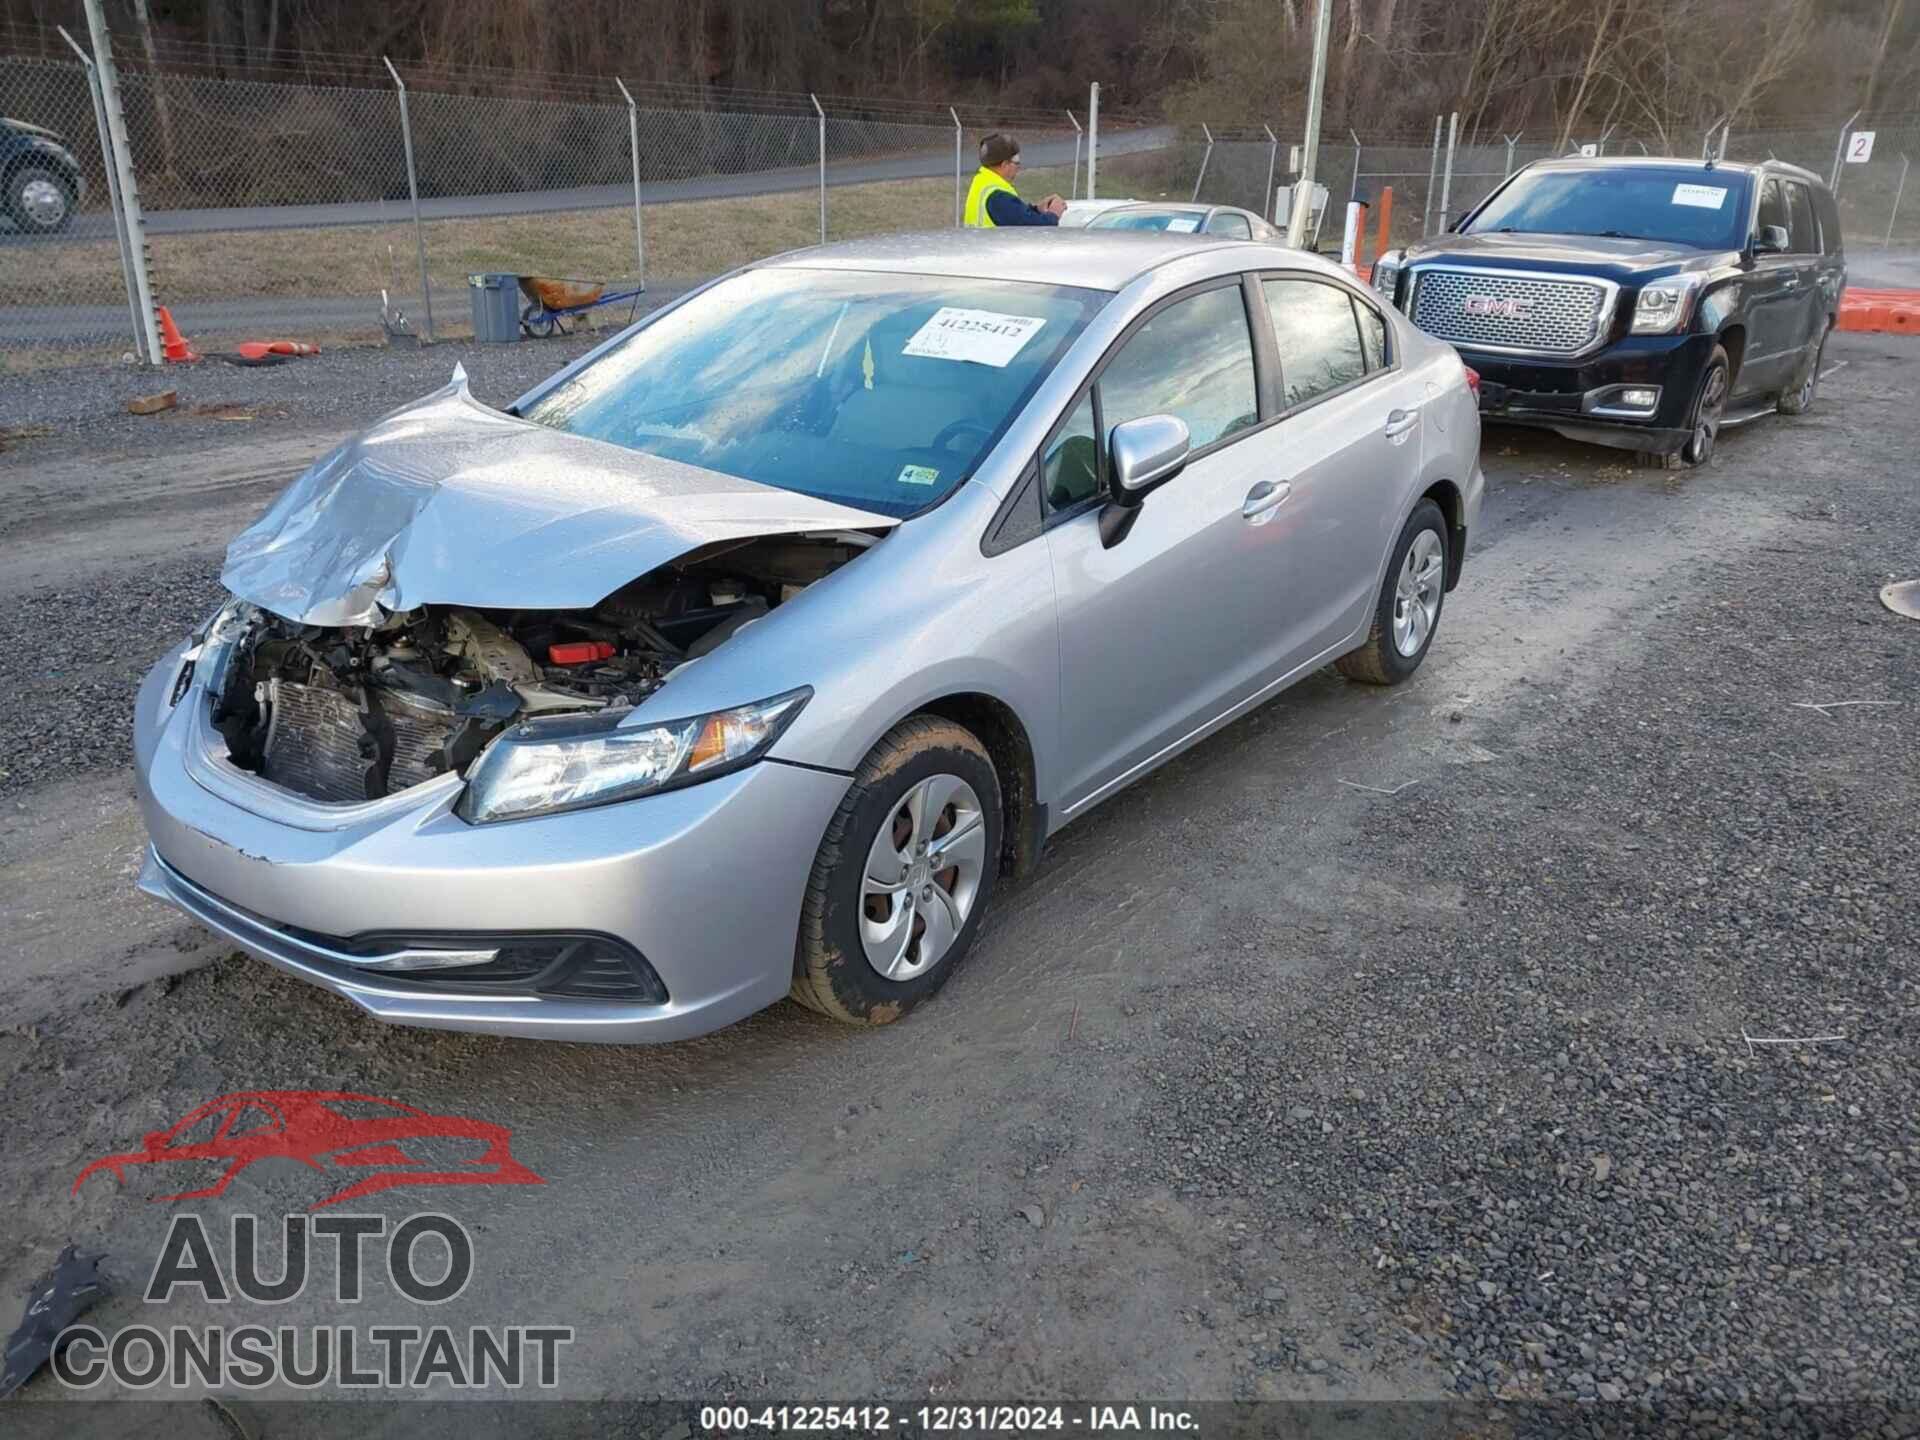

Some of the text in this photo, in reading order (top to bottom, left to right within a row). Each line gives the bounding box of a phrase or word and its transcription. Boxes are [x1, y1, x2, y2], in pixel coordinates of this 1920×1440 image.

[1854, 138, 1866, 156] 2
[1464, 295, 1533, 319] GMC
[938, 317, 1022, 337] 41225412
